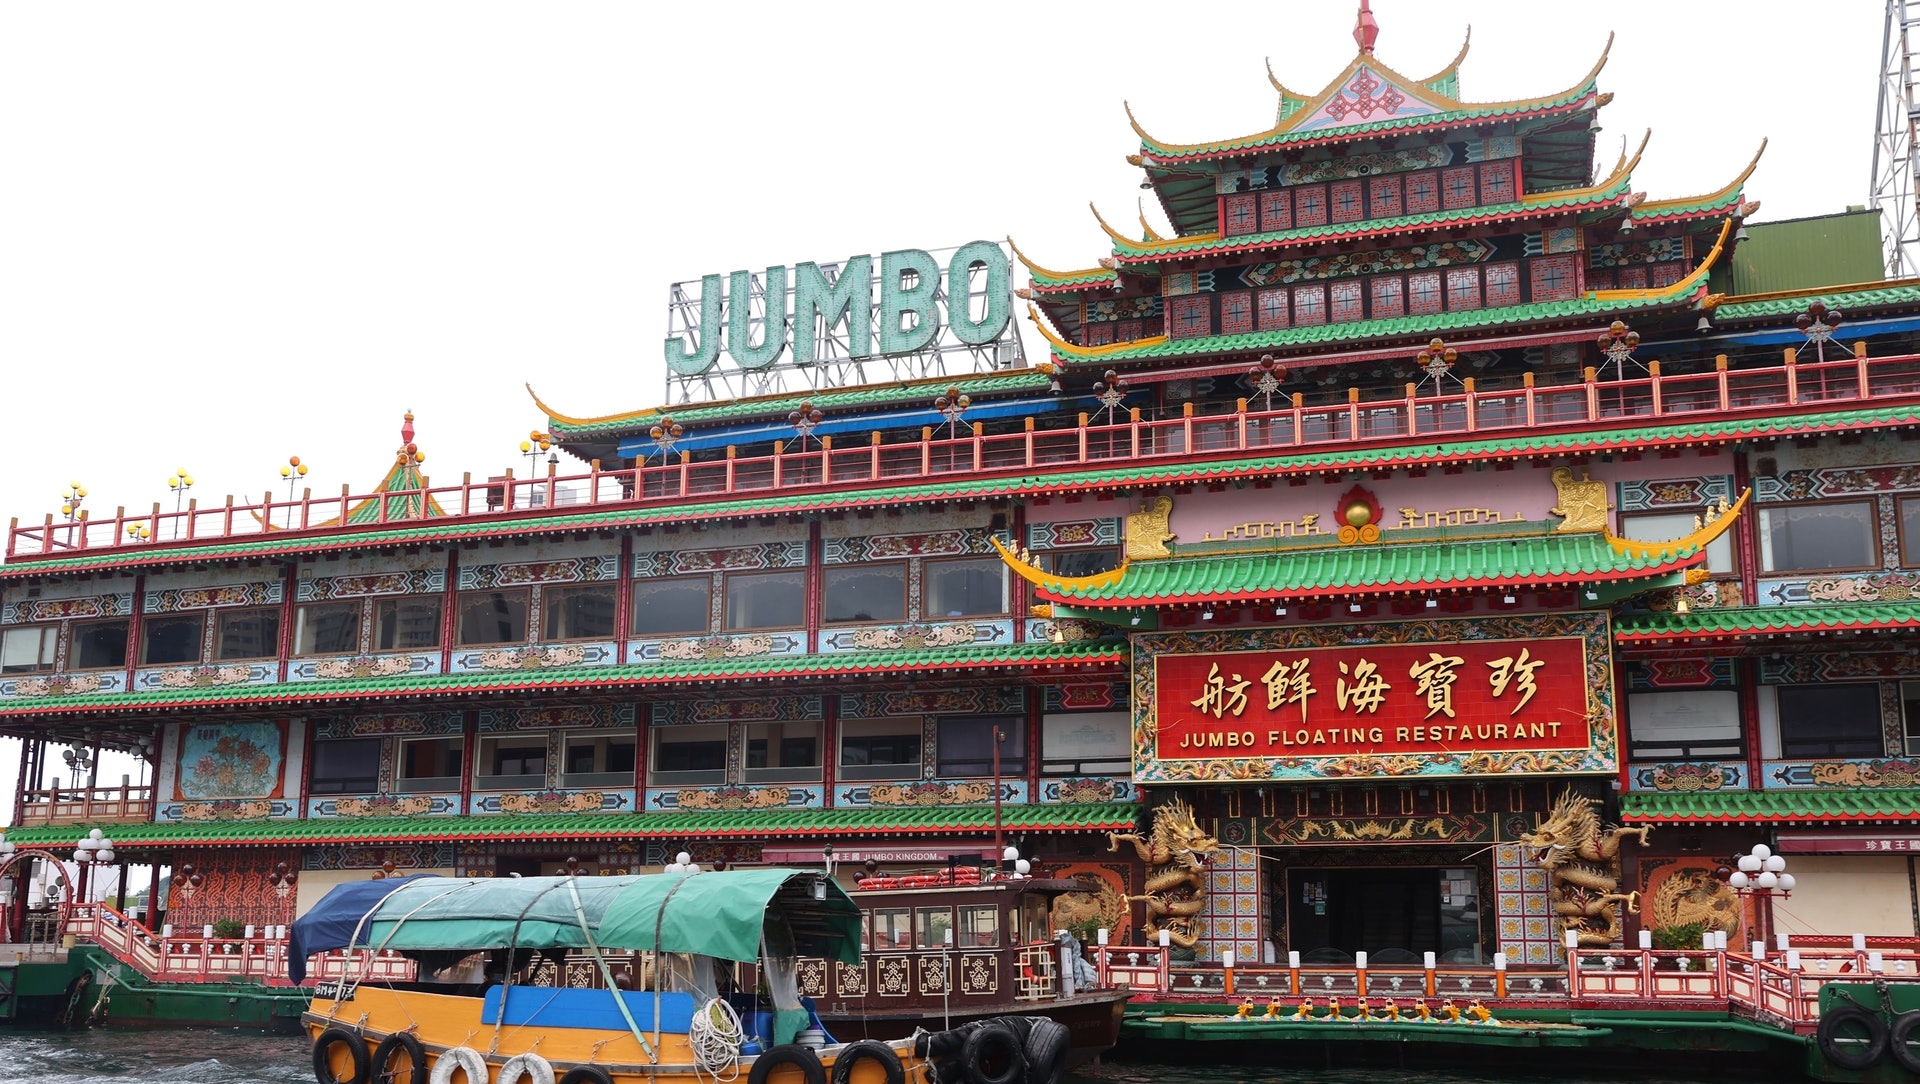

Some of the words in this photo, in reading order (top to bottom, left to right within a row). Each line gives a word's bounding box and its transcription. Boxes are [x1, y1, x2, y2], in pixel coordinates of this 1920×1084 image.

[664, 240, 1011, 376] JUMBO
[1180, 731, 1255, 748] JUMBO
[1268, 727, 1383, 746] FLOATING
[1396, 722, 1561, 742] RESTAURANT
[863, 853, 893, 861] JUMBO
[896, 852, 937, 861] KINGDOM
